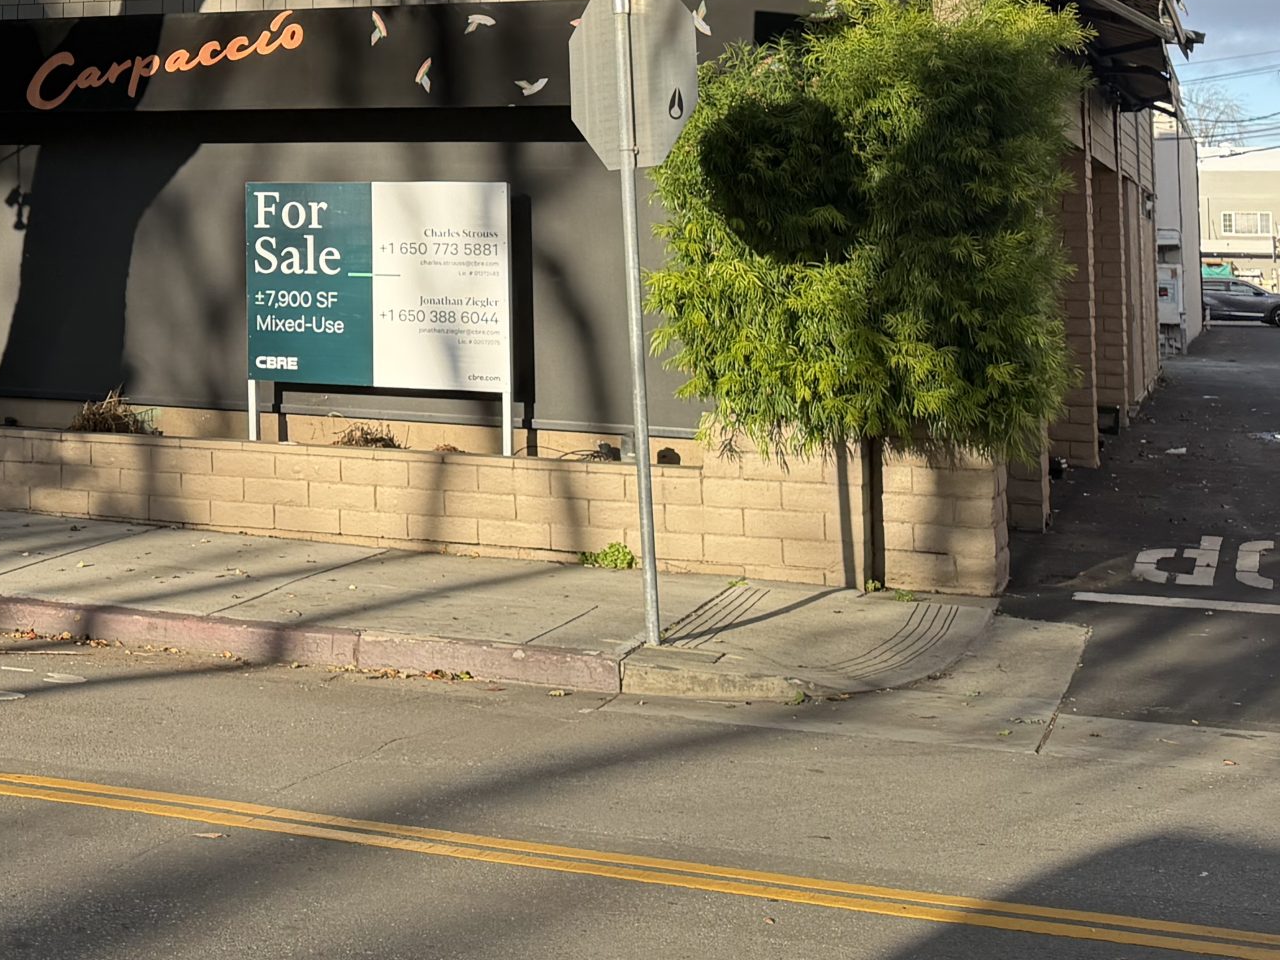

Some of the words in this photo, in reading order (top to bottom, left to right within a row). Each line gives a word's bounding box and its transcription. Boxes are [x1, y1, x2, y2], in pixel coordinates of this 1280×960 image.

[26, 10, 304, 110] Carpaccio
[253, 191, 327, 229] For
[424, 228, 460, 238] Charles
[462, 229, 498, 238] Strouss
[254, 235, 341, 276] Sale
[380, 243, 394, 254] +1
[400, 243, 428, 255] 650
[433, 243, 458, 255] 773
[464, 243, 498, 256] 5881
[255, 290, 312, 309] ±7,900
[316, 291, 338, 308] SF
[419, 296, 463, 307] Jonathan
[465, 297, 499, 308] Ziegler
[256, 314, 344, 333] Mixed-Use
[380, 309, 394, 321] +1
[399, 310, 425, 322] 650
[430, 310, 456, 323] 388
[461, 311, 498, 324] 6044
[255, 355, 298, 370] CBRE
[468, 372, 501, 382] cbre.com
